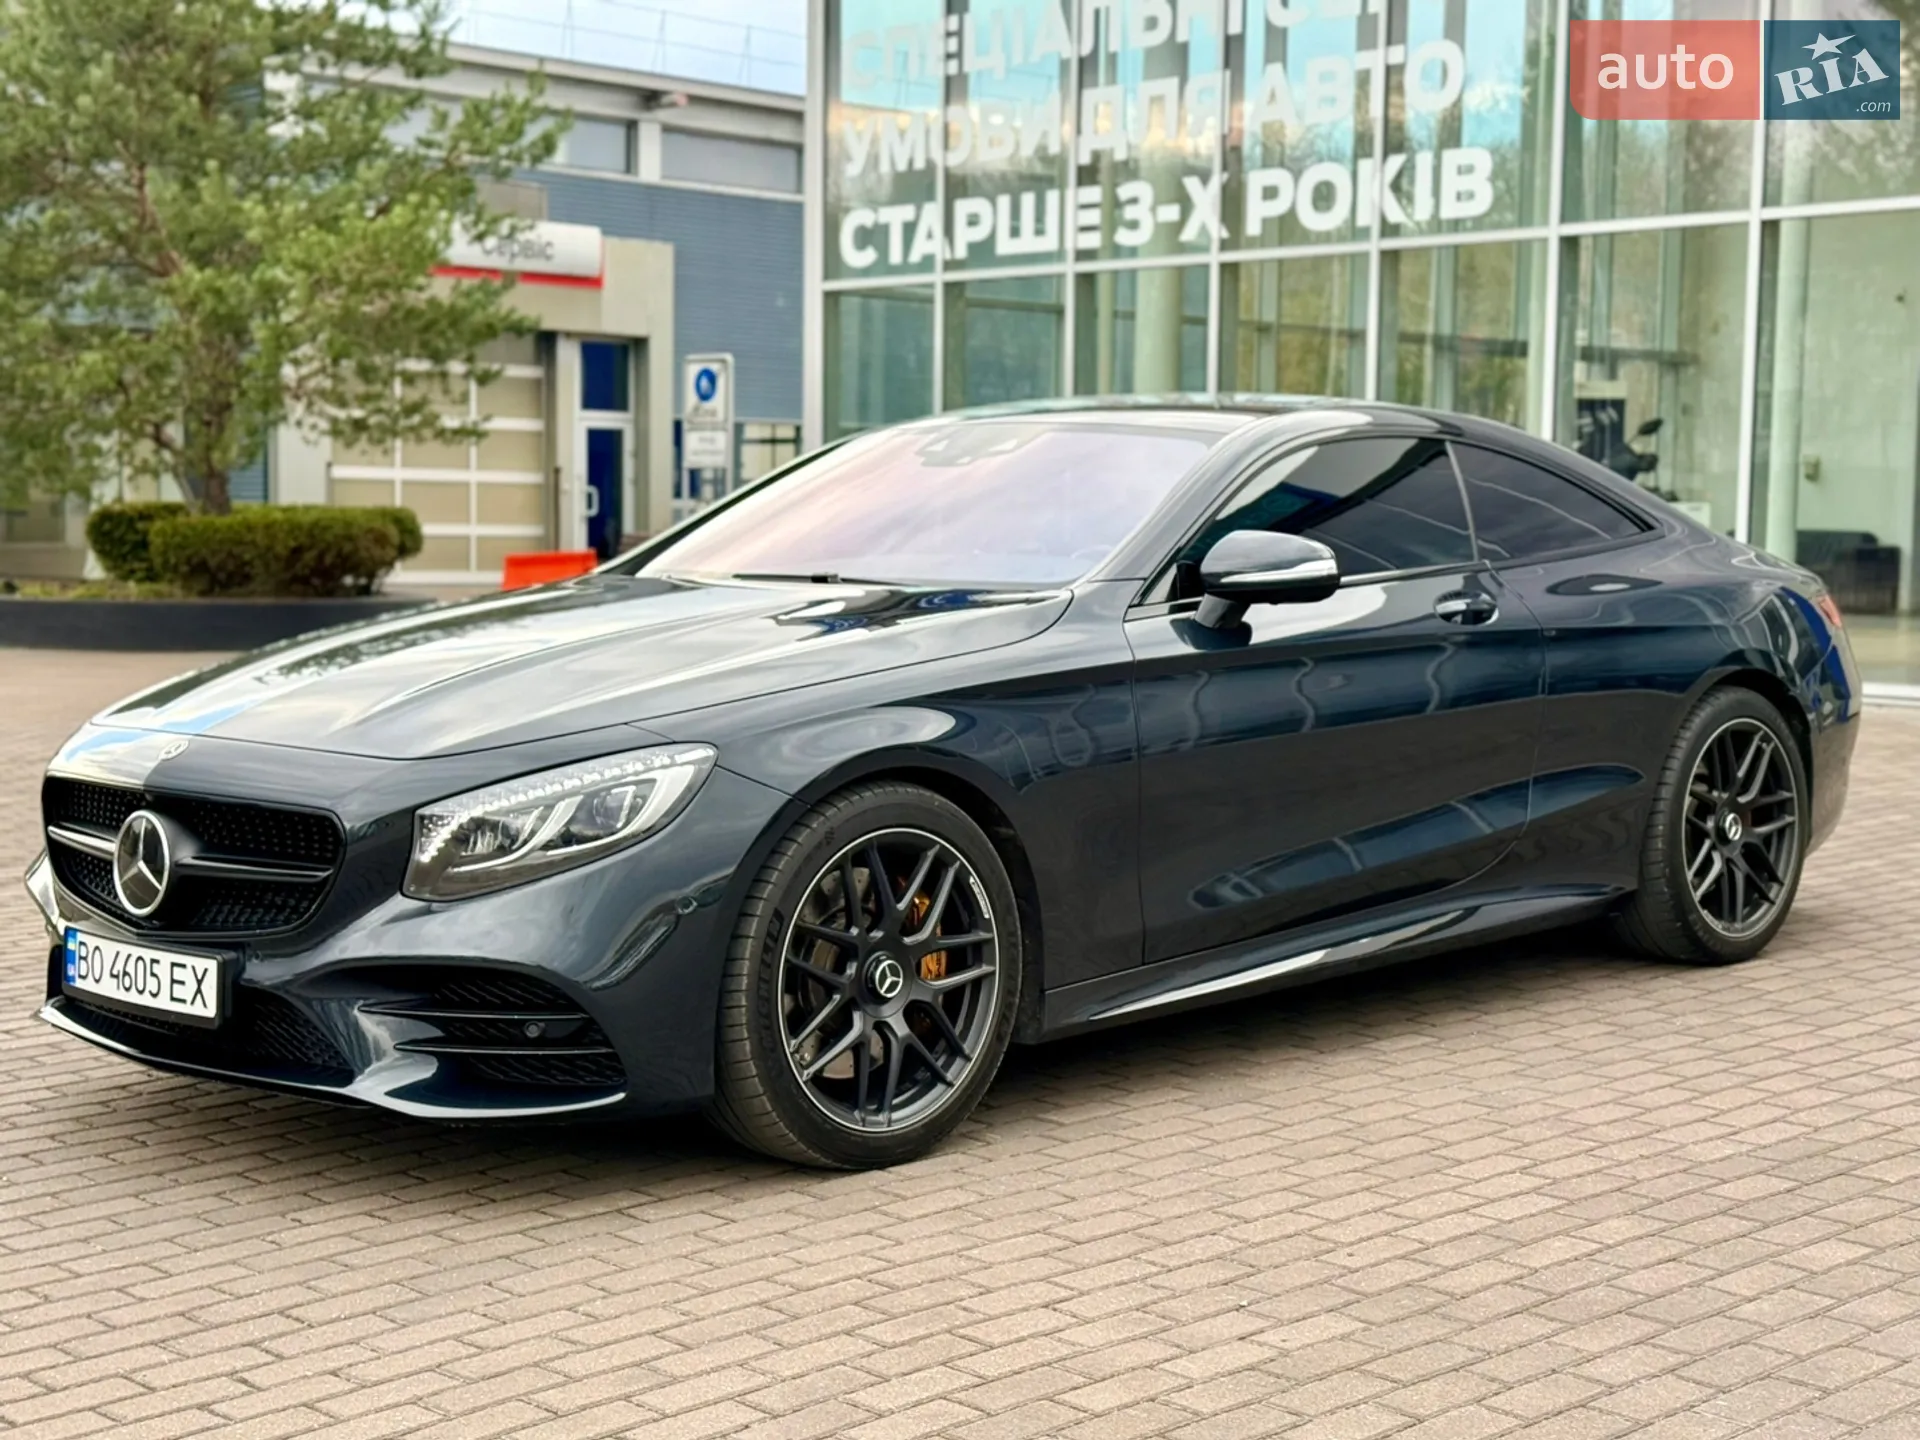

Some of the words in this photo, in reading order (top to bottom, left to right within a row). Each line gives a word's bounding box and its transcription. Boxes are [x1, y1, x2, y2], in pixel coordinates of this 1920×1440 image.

[845, 100, 1061, 176] УМОВИ
[1079, 71, 1230, 165] ДЛЯ
[1249, 40, 1464, 132] АВТО
[839, 187, 1101, 267] СТАРШЕ
[1246, 148, 1494, 237] РОКІВ
[78, 941, 104, 984] BO
[110, 951, 161, 998] 4605
[170, 961, 209, 1009] EX
